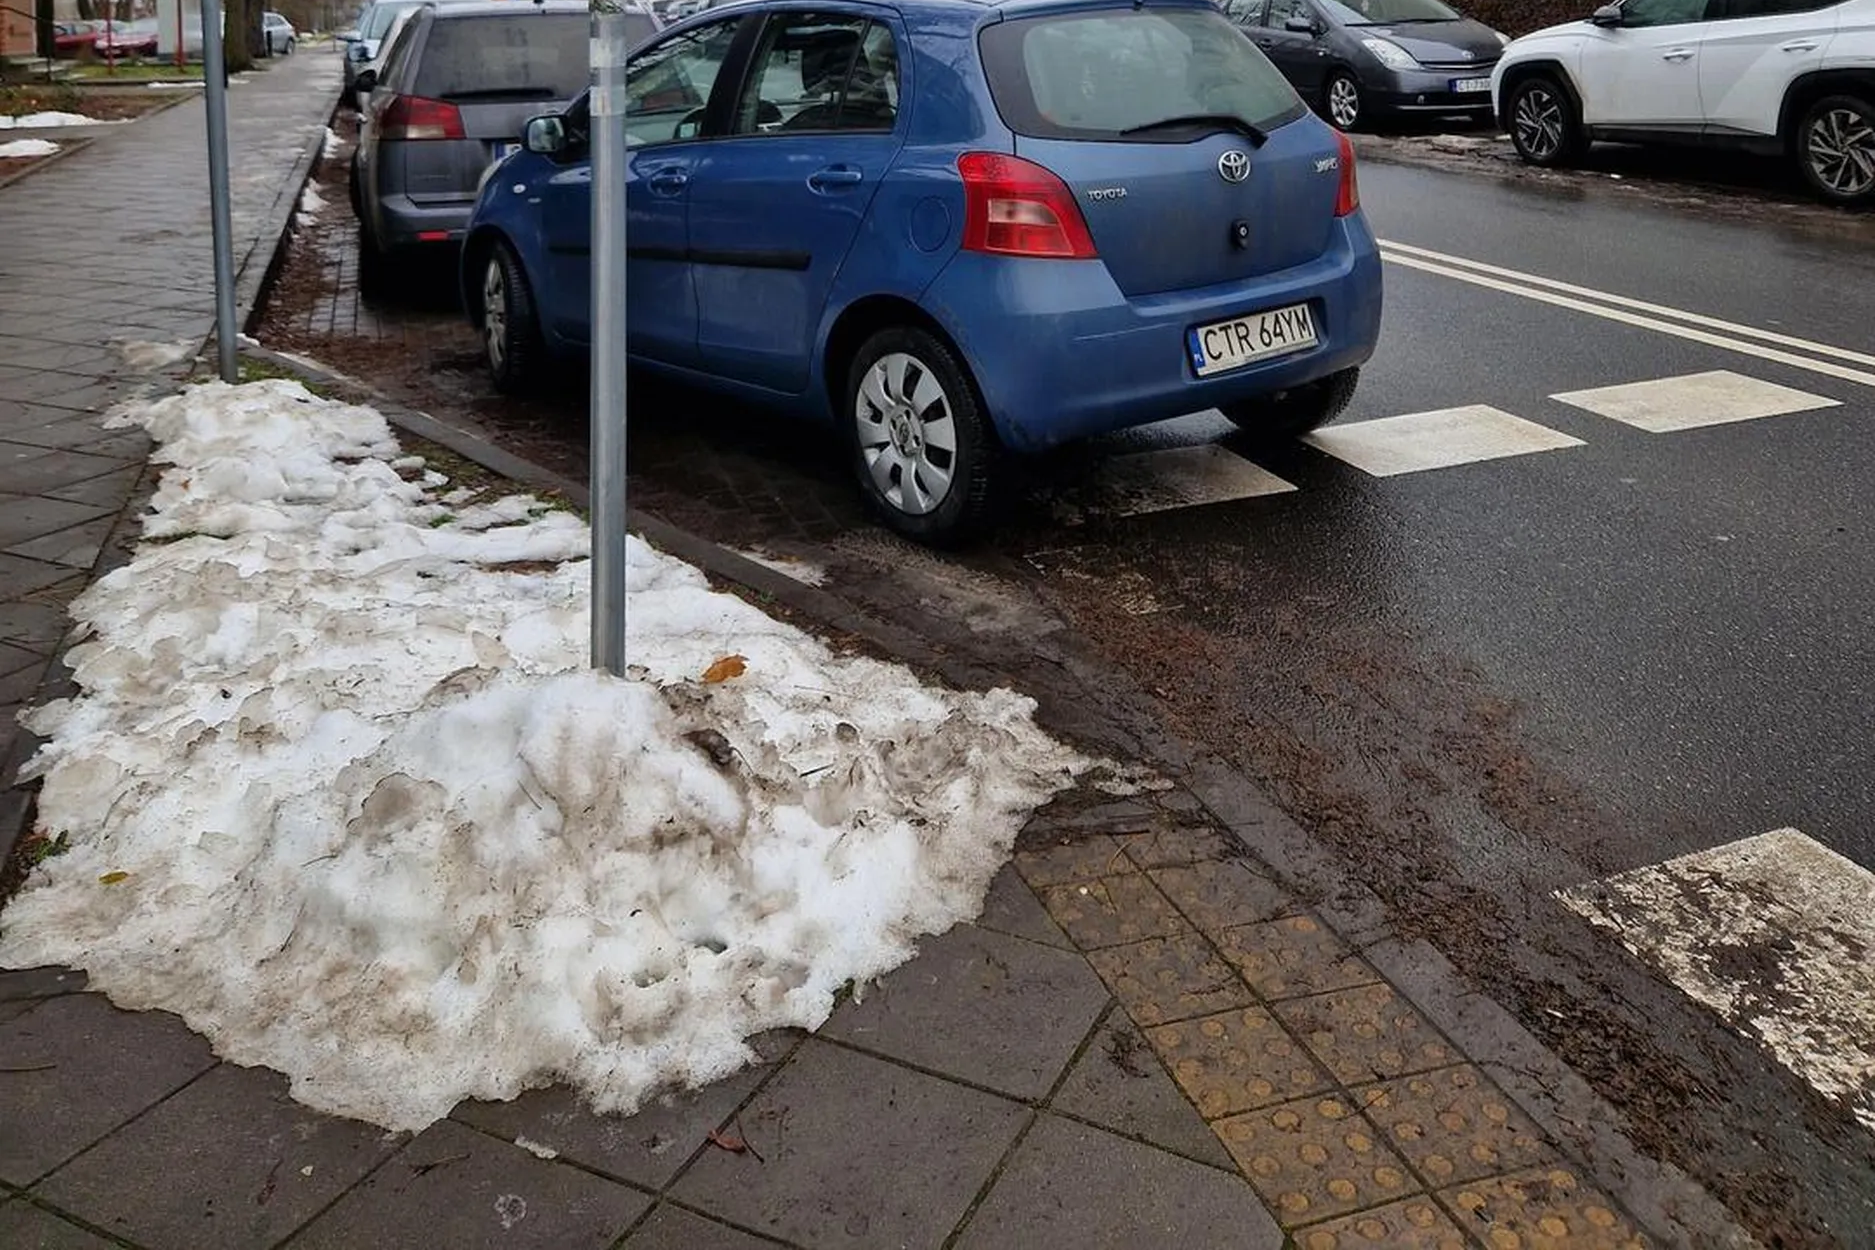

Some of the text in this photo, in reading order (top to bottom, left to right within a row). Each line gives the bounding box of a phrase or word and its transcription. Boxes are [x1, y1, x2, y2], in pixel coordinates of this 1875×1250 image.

[1087, 187, 1128, 200] TOYOTA
[1203, 306, 1313, 361] CTR 64YM
